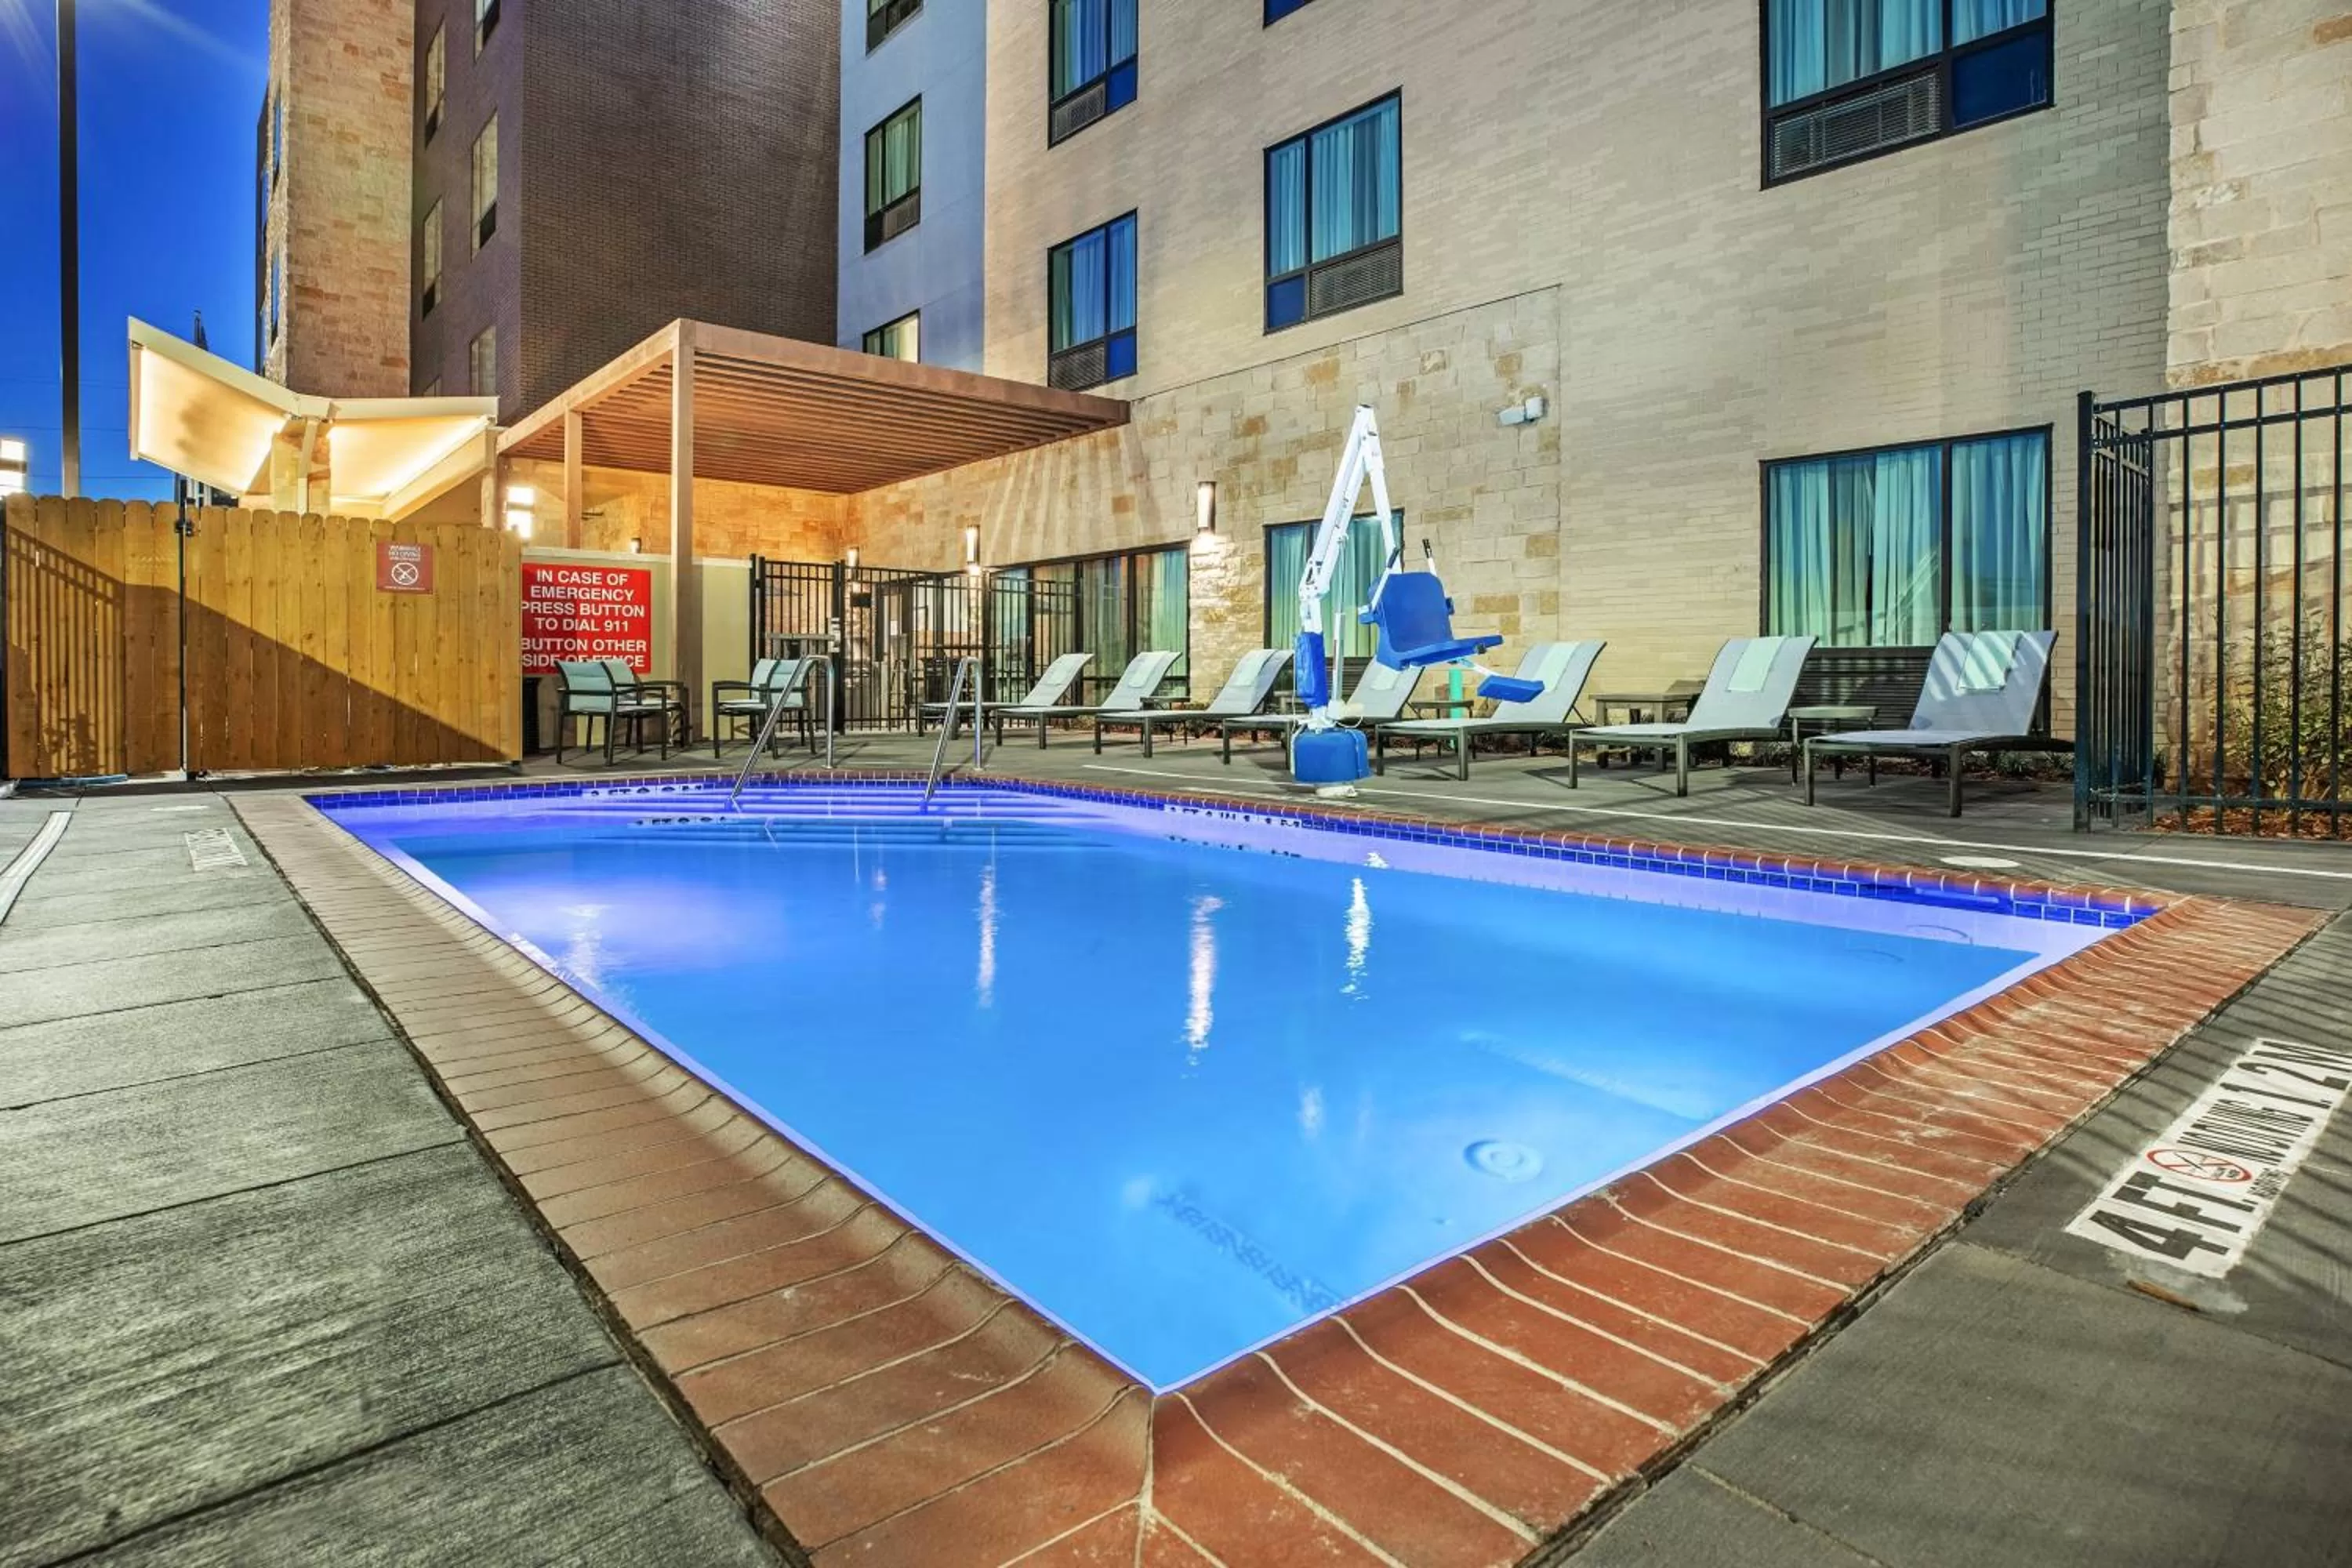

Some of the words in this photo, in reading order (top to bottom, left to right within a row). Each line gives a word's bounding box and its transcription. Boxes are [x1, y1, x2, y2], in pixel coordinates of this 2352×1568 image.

[536, 569, 553, 582] IN
[557, 570, 602, 585] CASE
[606, 573, 629, 586] OF
[530, 585, 635, 601] EMERGENCY
[521, 601, 575, 615] PRESS
[579, 603, 644, 617] BUTTON
[534, 617, 558, 630] TO
[562, 619, 600, 631] DIAL
[604, 620, 629, 632] 911
[521, 637, 588, 652] BUTTON
[592, 639, 647, 652] OTHER
